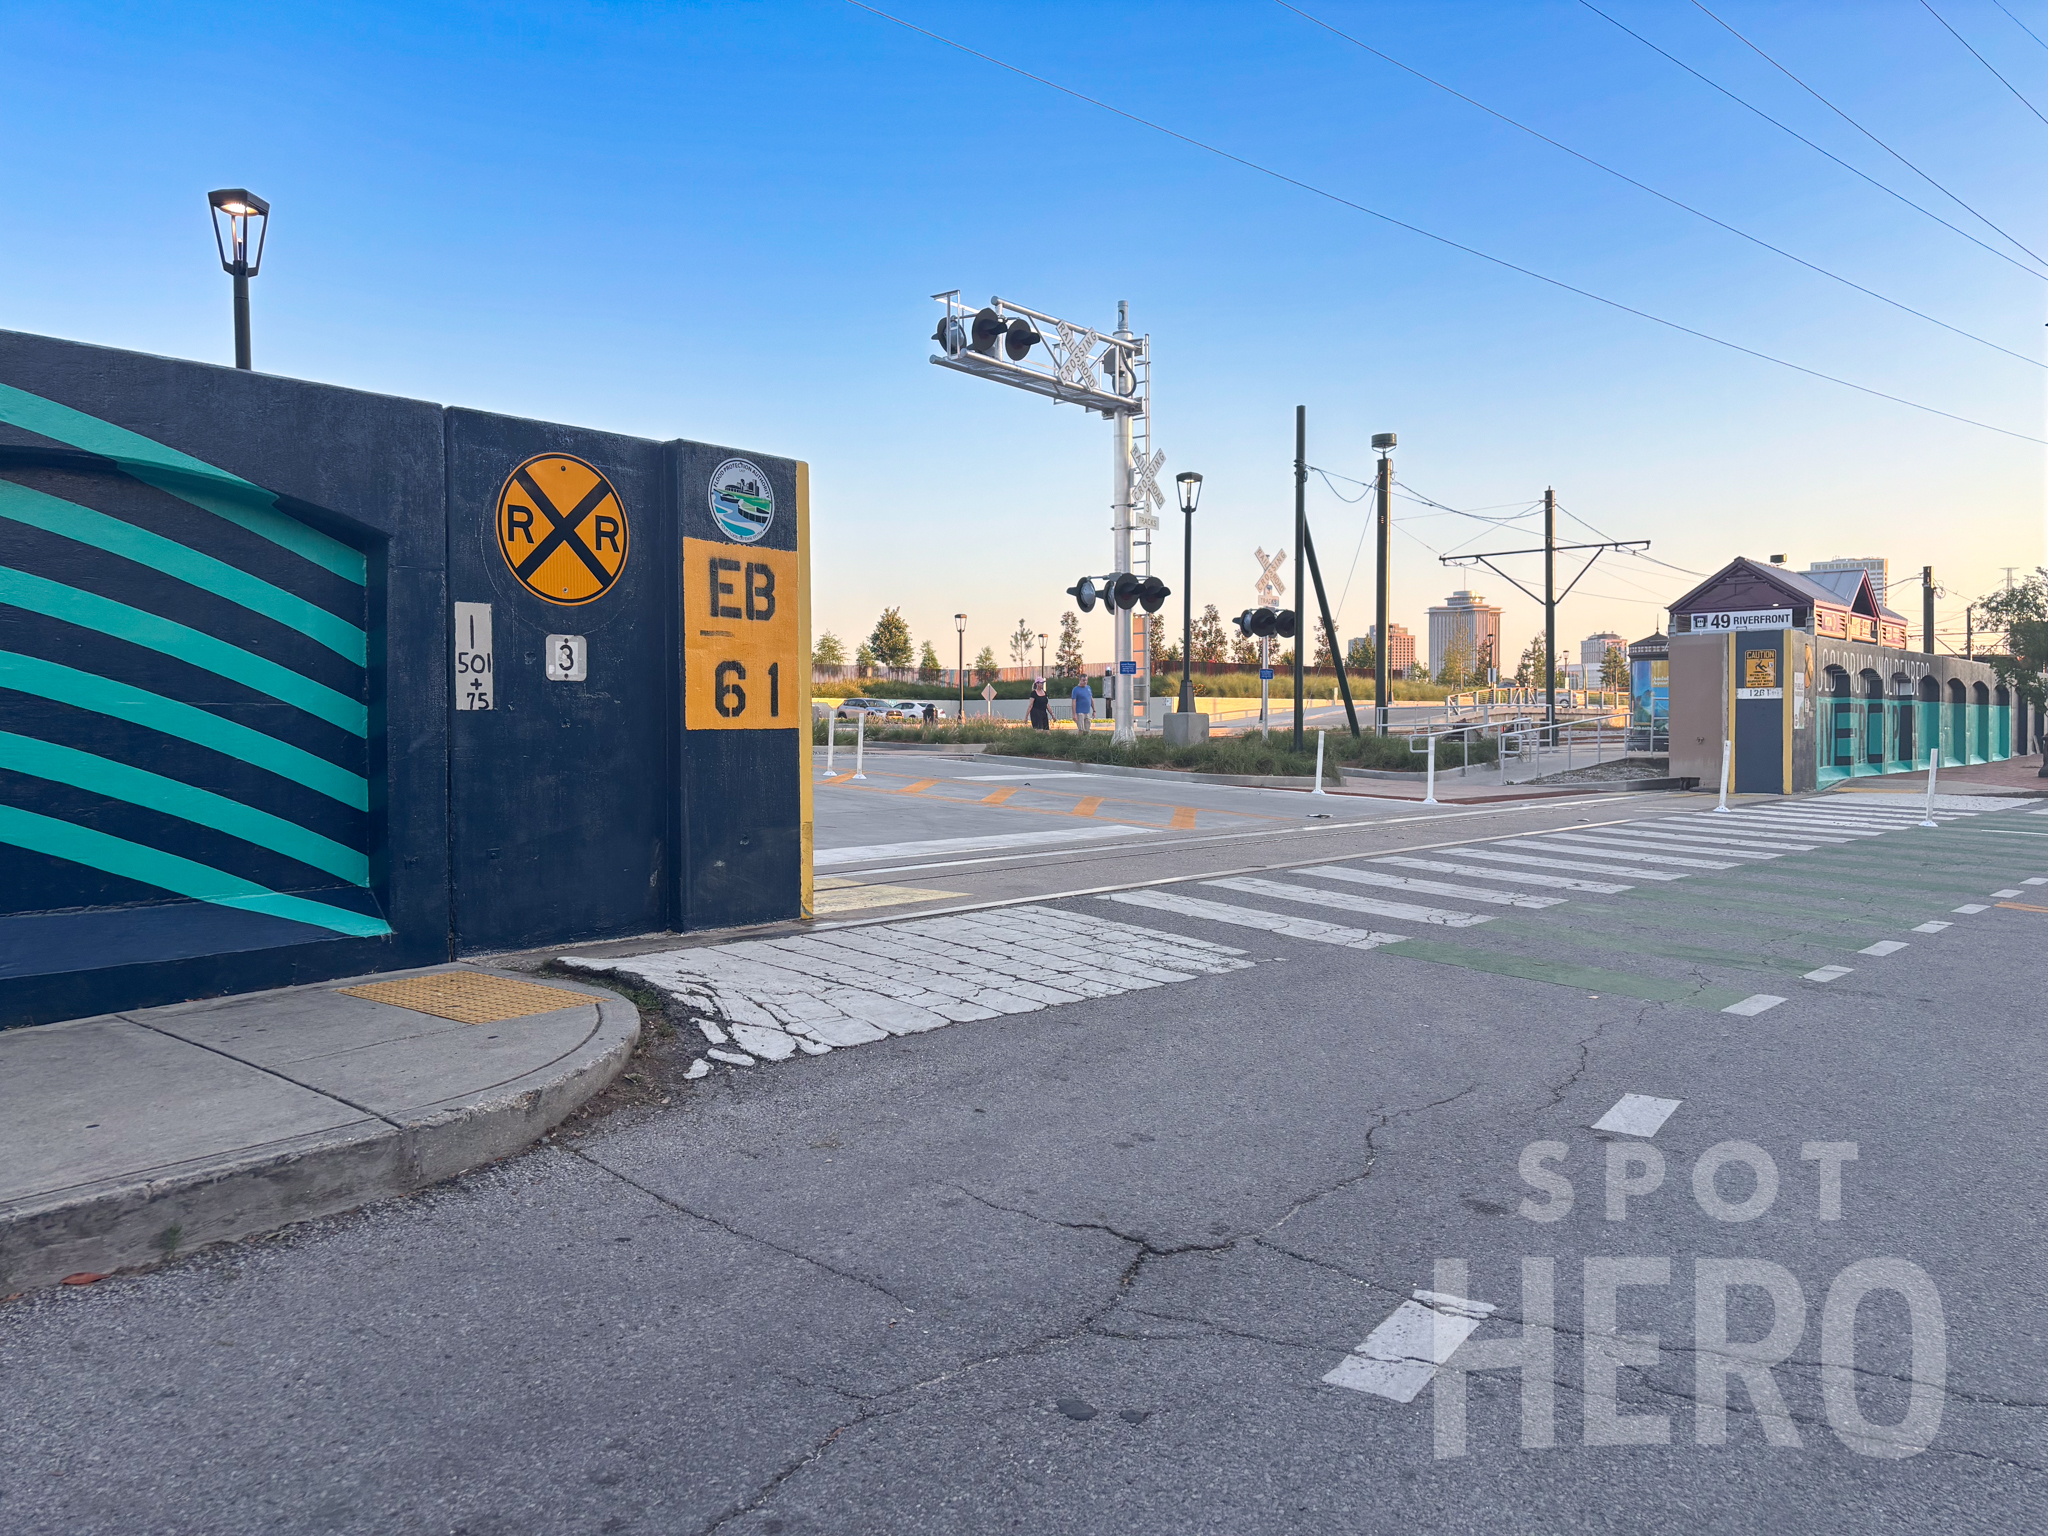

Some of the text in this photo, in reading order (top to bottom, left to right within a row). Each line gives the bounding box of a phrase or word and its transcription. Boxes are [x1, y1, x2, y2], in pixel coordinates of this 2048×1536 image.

[1058, 323, 1096, 388] RAIL ROAD
[1060, 331, 1097, 381] CROSSING
[713, 462, 771, 499] FLOOD PROTECTION AUTHORITY
[1132, 446, 1164, 505] RAIL ROAD
[1134, 452, 1165, 501] CROSSING
[1138, 516, 1157, 527] TRACKS
[1145, 503, 1150, 513] 3
[507, 504, 620, 553] R R
[1256, 548, 1269, 570] RAIL
[1257, 551, 1286, 591] CROSSING
[709, 557, 775, 621] EB
[1711, 613, 1791, 629] 49 RIVERFRONT
[458, 652, 492, 674] 501
[559, 644, 574, 671] 3
[1746, 650, 1775, 660] CAUTION
[466, 692, 490, 710] 75
